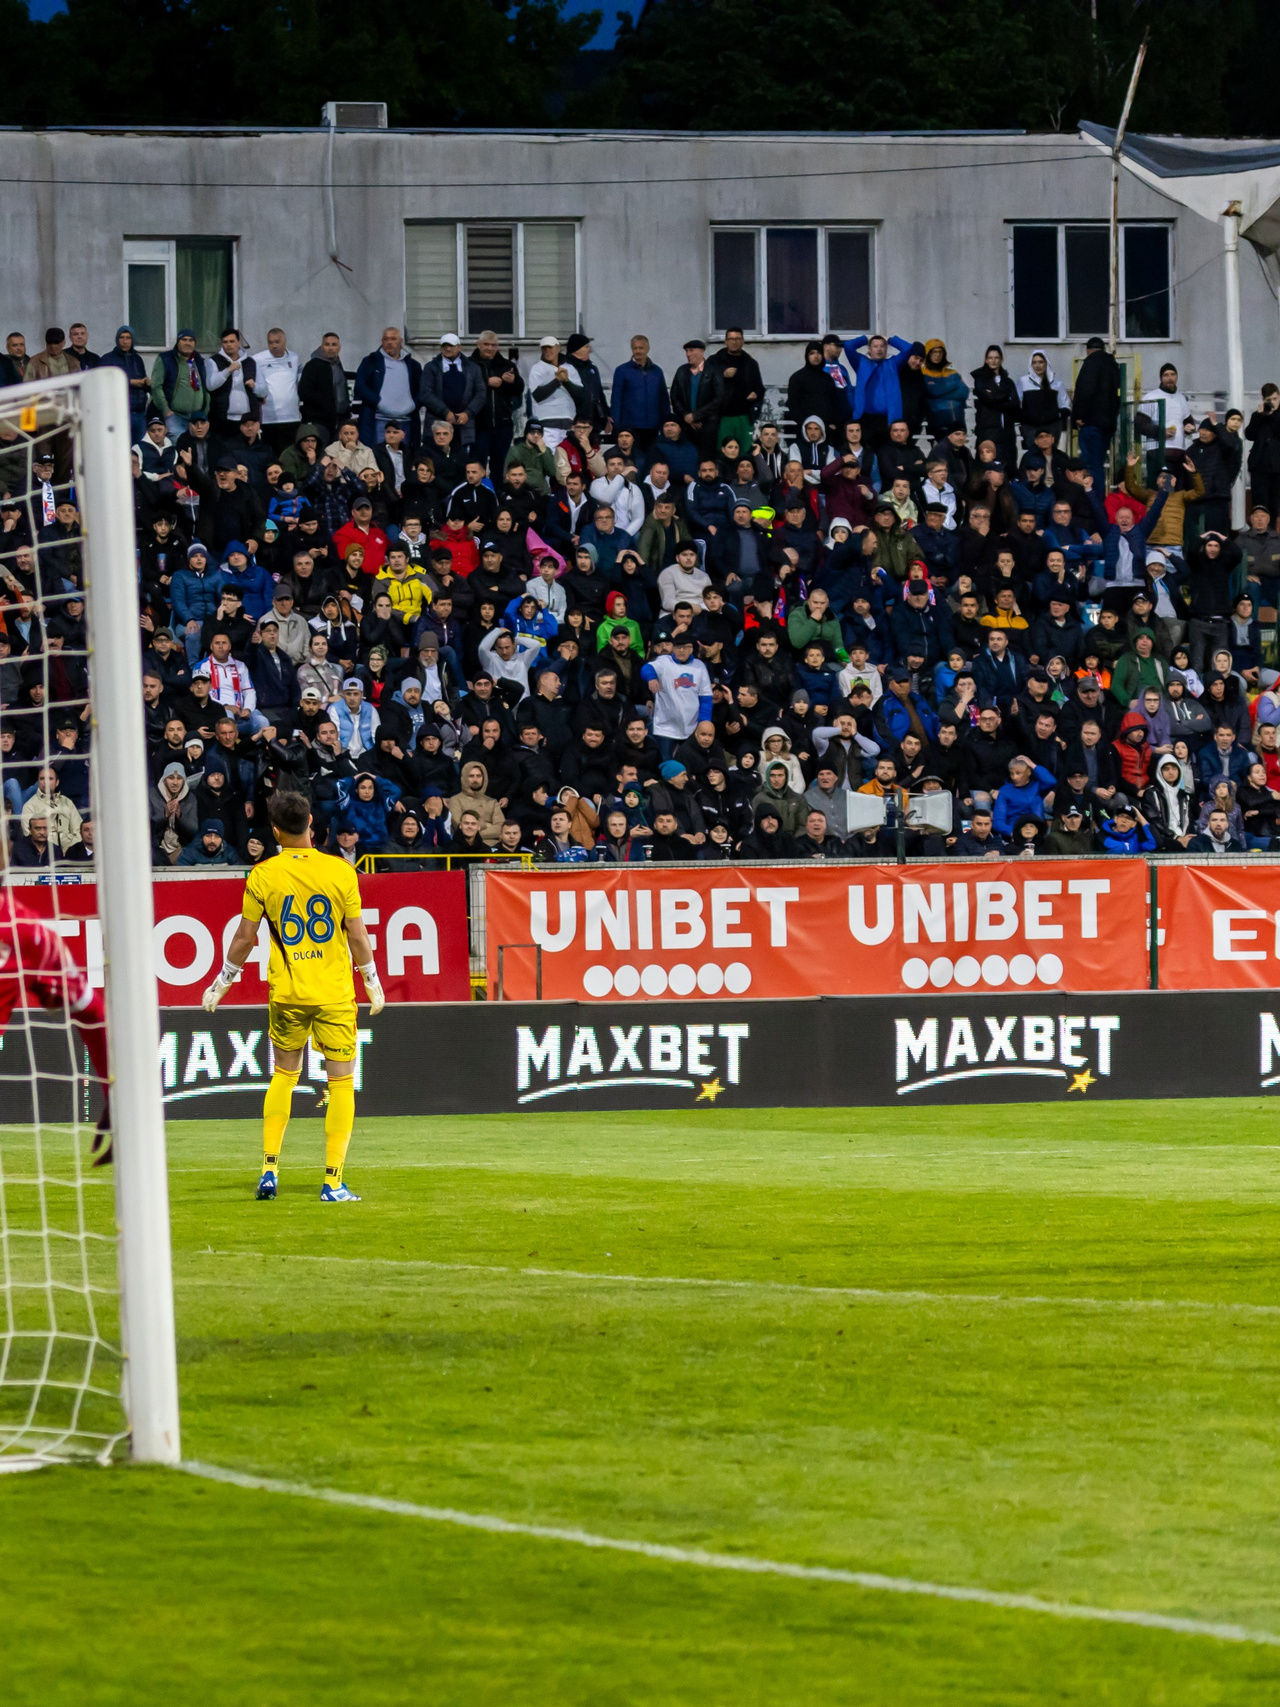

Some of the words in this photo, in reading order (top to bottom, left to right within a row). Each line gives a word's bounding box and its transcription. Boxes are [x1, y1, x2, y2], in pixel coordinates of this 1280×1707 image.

[280, 894, 335, 945] 68
[530, 887, 799, 952] UNIBET
[848, 879, 1110, 946] UNIBET
[293, 950, 323, 961] DUCAN
[518, 1023, 749, 1091] MAXBET
[895, 1014, 1120, 1082] MAXBET
